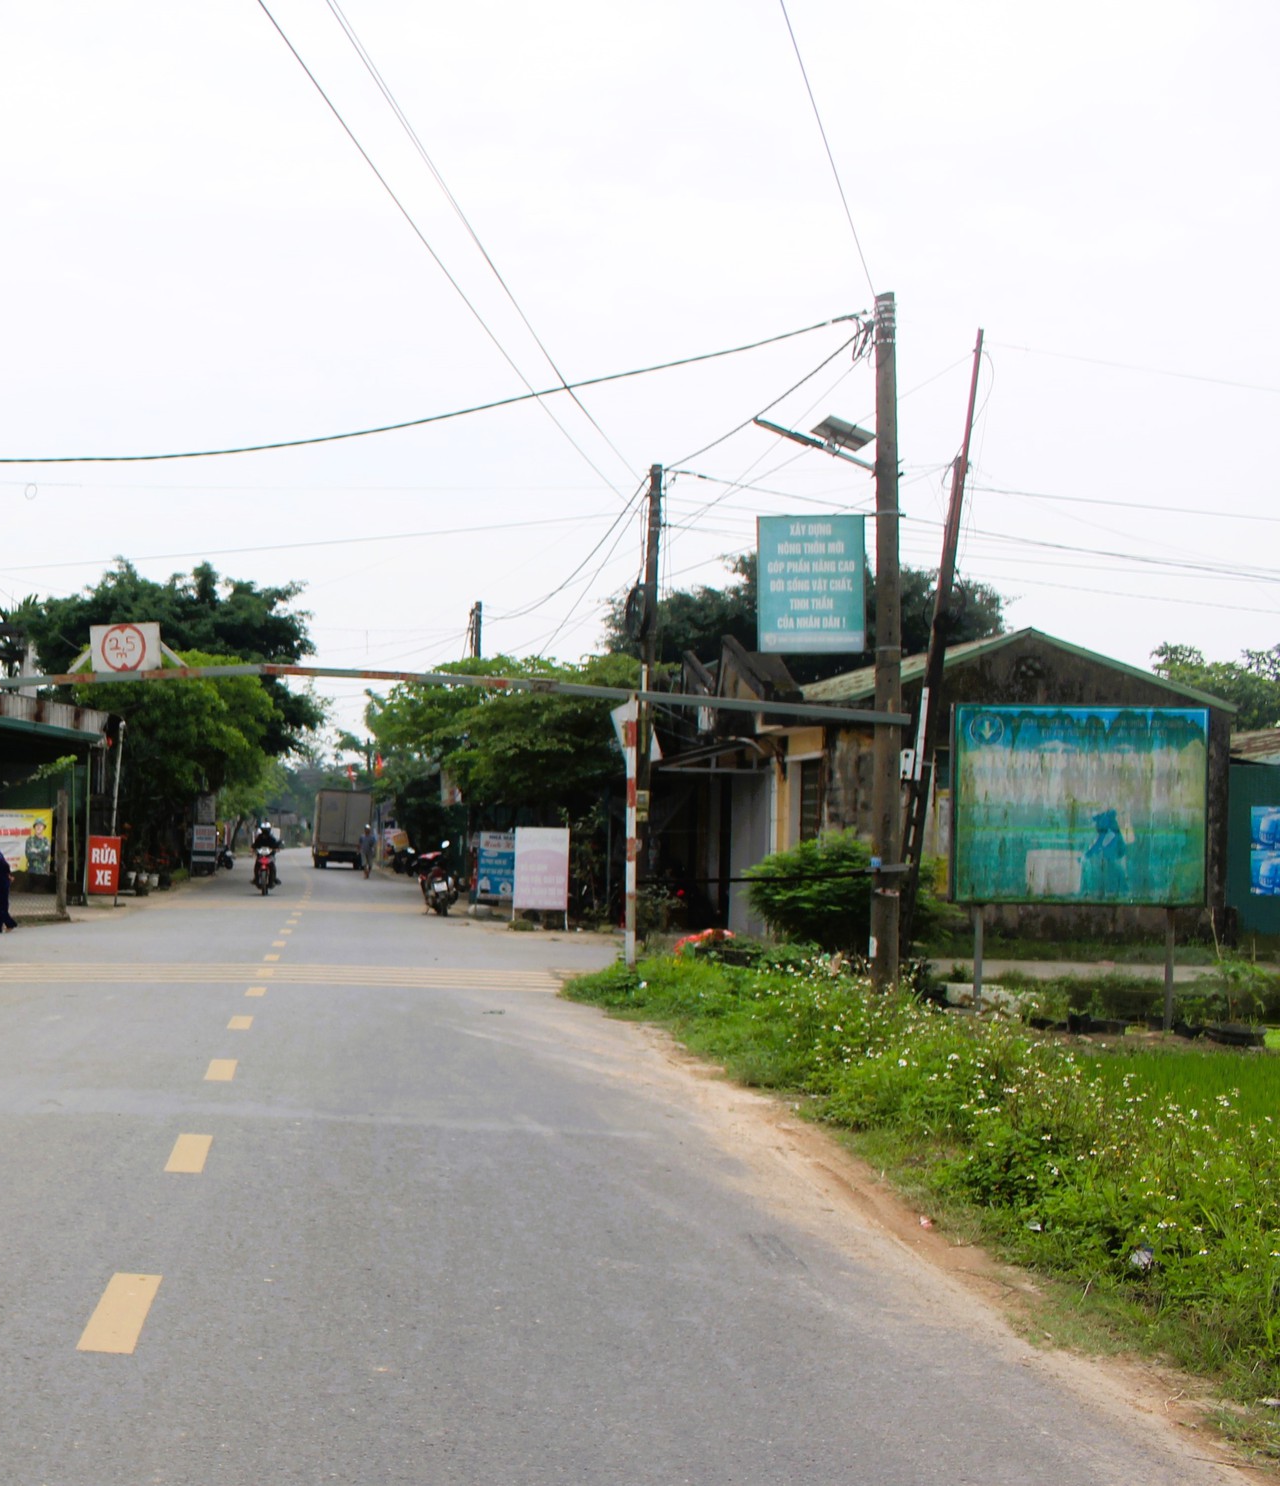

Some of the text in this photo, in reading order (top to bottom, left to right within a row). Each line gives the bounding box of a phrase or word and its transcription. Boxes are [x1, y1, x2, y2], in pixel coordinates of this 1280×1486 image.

[789, 523, 806, 536] XÂY
[777, 541, 801, 554] NÔNG
[804, 540, 825, 554] THÔN
[838, 561, 855, 572] CAO
[790, 598, 809, 610] TINH
[91, 843, 117, 865] RỬA
[95, 869, 112, 886] XE
